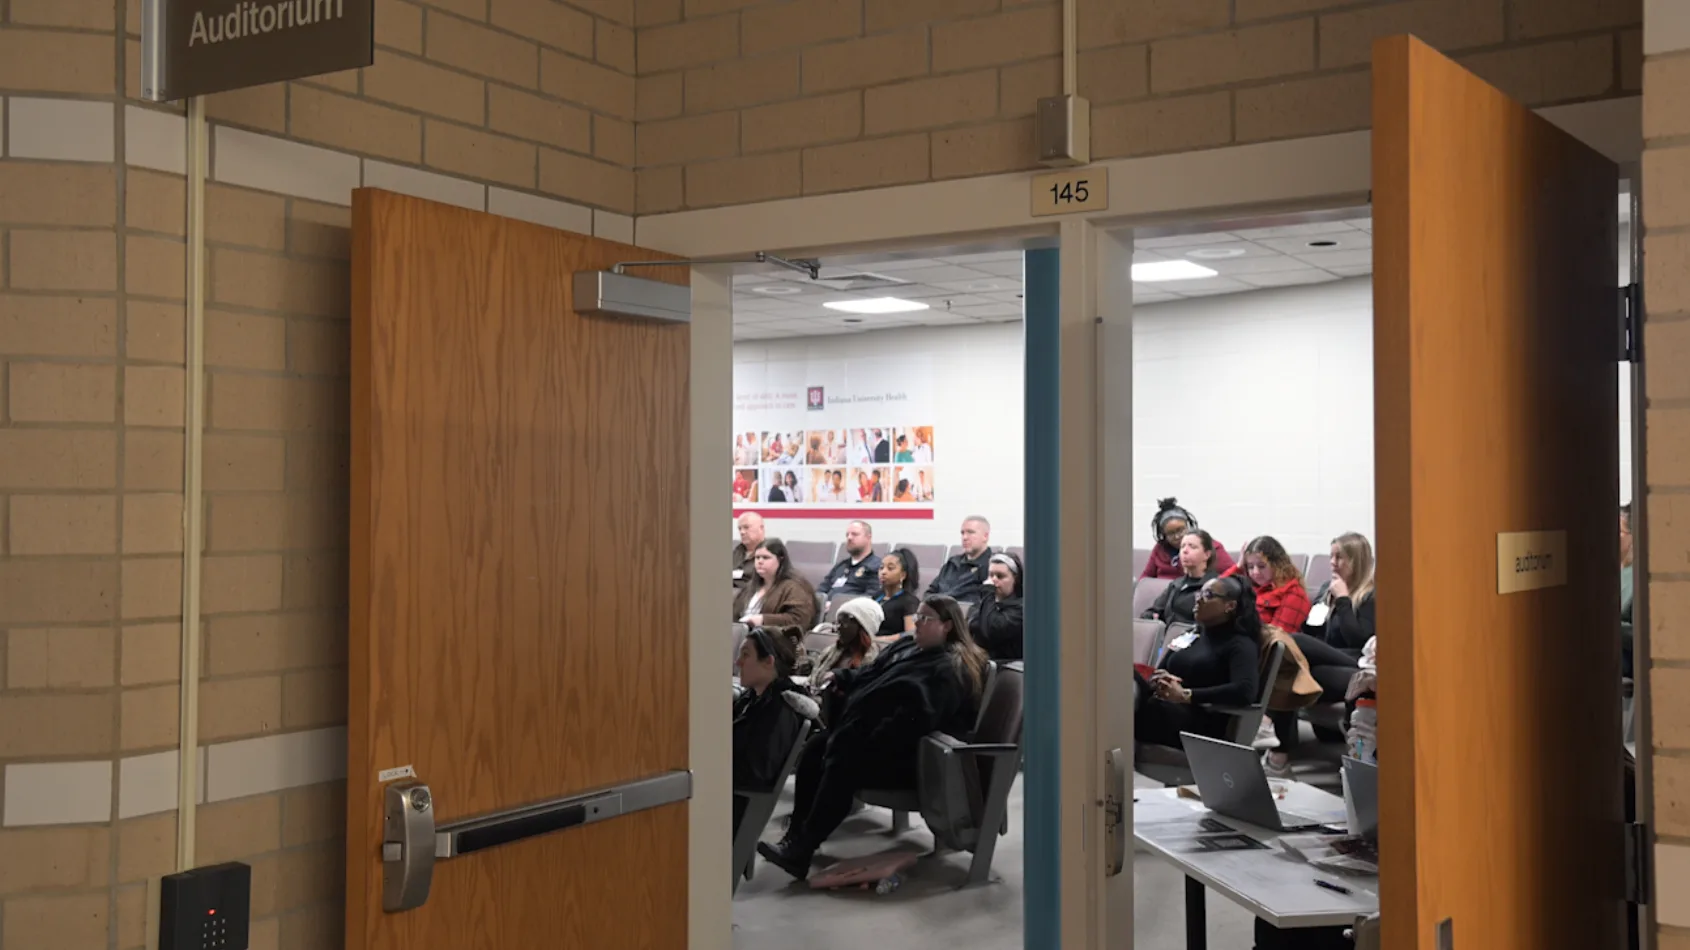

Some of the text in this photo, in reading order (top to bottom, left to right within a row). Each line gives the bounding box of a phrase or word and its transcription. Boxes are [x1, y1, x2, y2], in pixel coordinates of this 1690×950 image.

[188, 0, 343, 47] Auditorium
[1050, 180, 1089, 205] 145
[827, 392, 907, 405] Indiana University Health
[1515, 551, 1553, 573] auditorium
